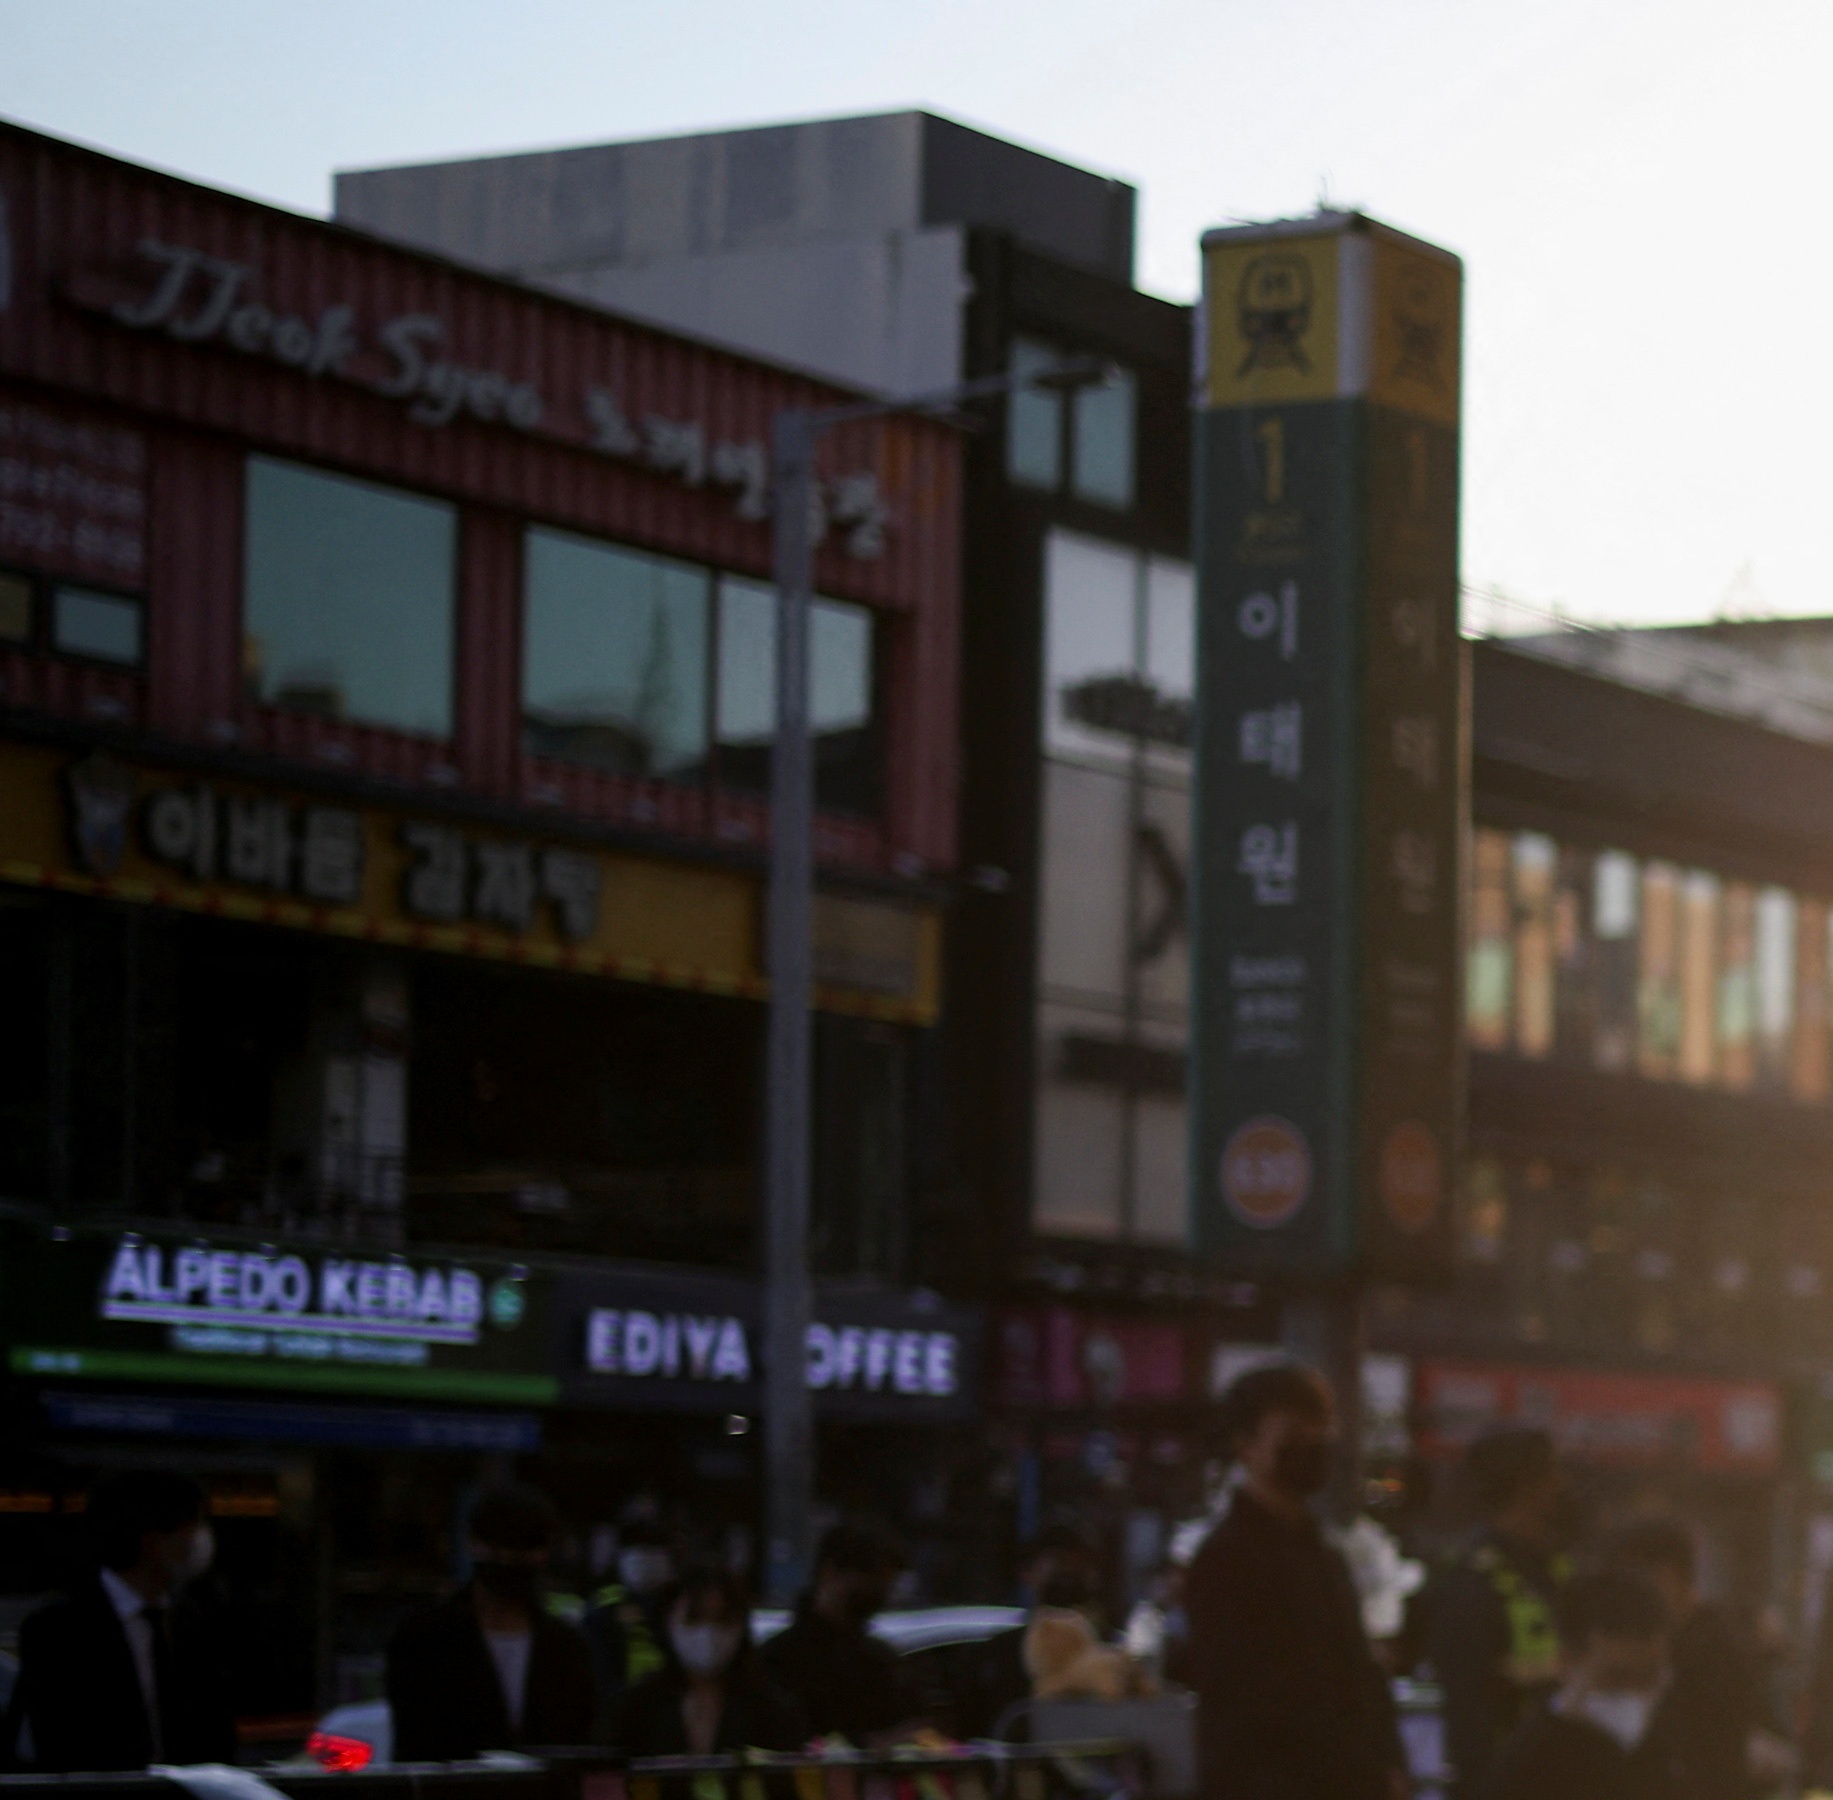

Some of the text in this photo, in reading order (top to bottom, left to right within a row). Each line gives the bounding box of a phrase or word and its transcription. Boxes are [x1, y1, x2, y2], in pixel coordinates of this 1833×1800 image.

[1235, 577, 1304, 907] 이태원
[106, 1242, 484, 1326] ALPEDO KEBAB
[587, 1306, 957, 1397] EDIYA OFFEE
